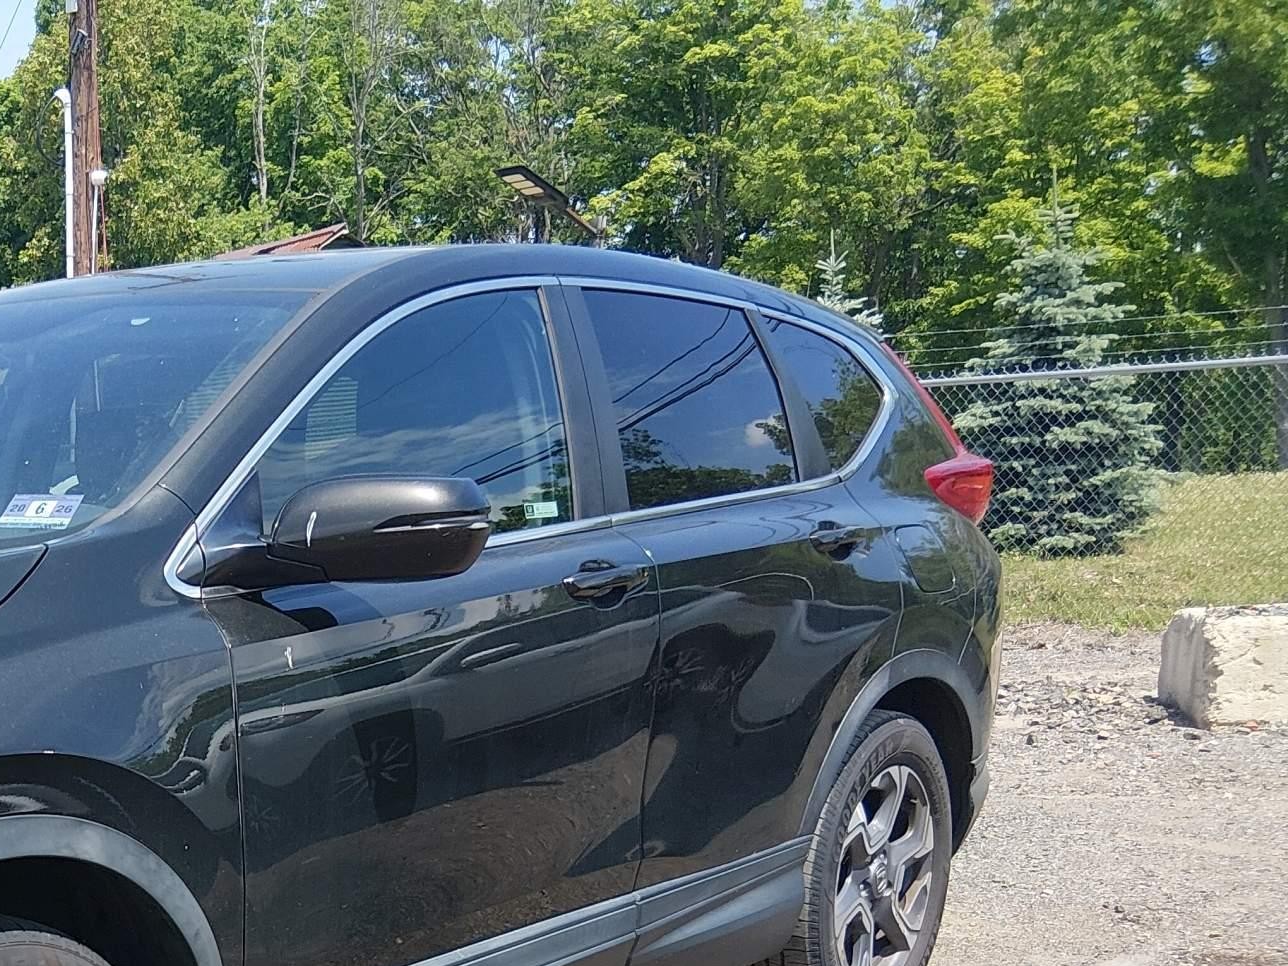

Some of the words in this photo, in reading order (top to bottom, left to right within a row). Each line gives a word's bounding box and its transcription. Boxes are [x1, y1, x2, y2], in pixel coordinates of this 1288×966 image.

[9, 503, 26, 513] 20
[35, 502, 47, 515] 6
[55, 504, 73, 514] 26
